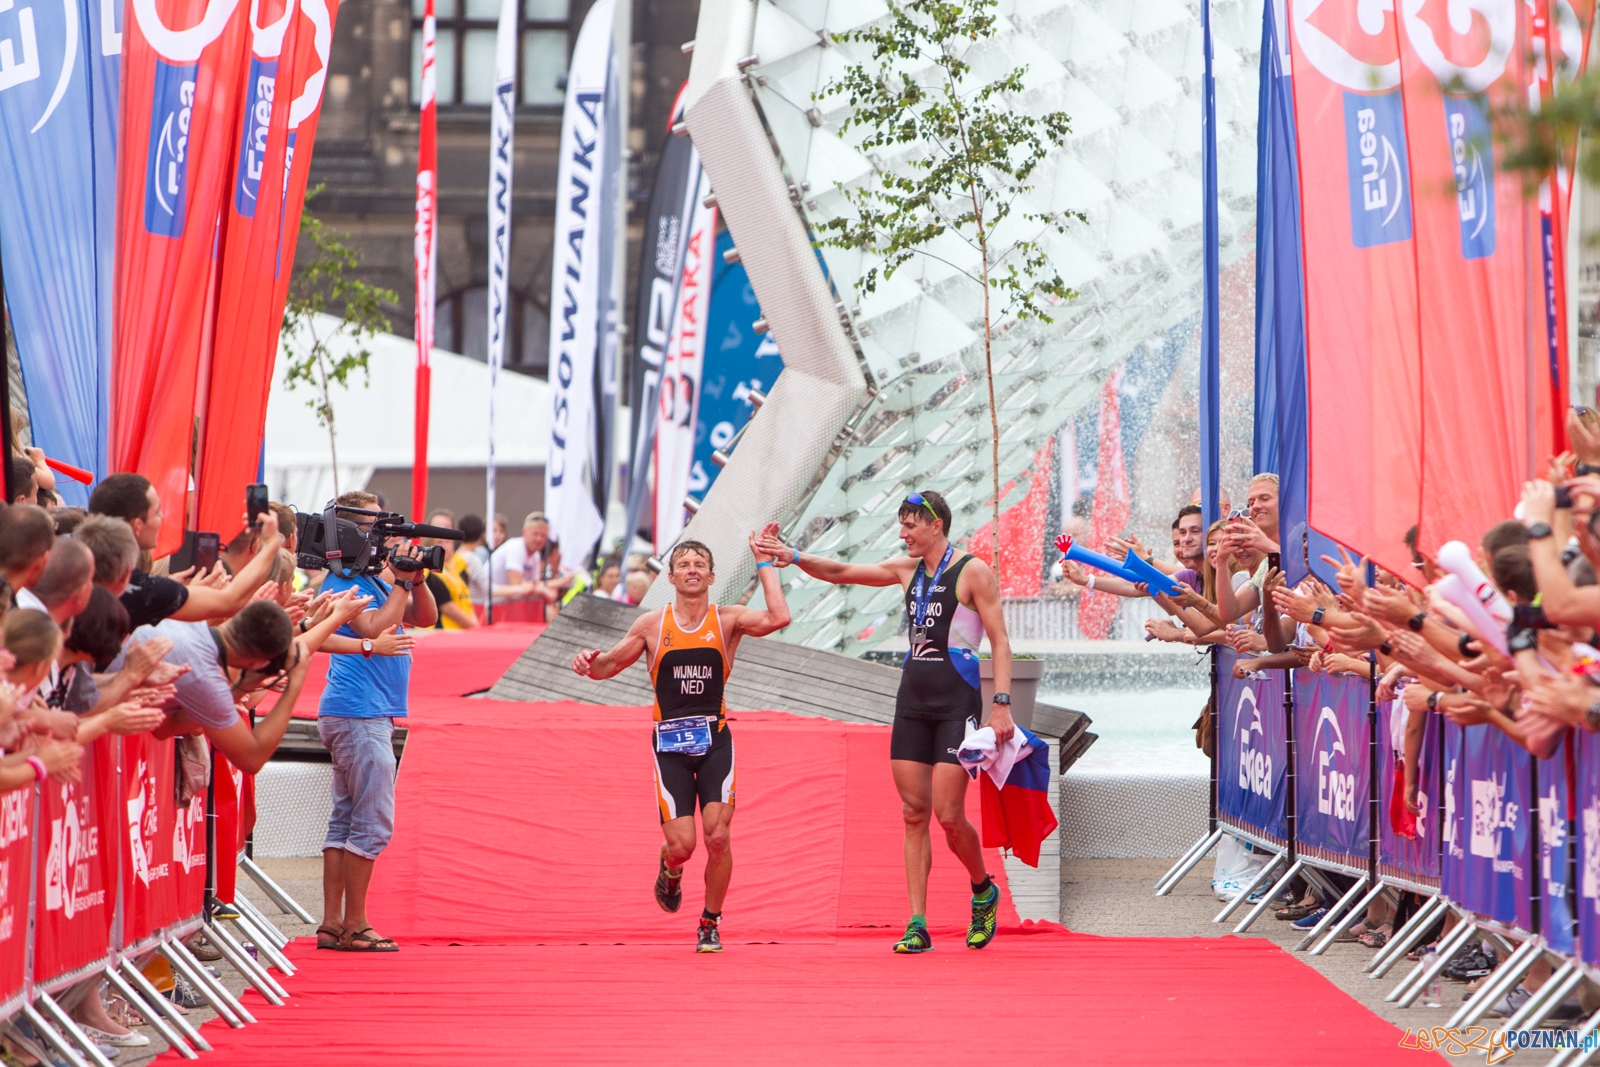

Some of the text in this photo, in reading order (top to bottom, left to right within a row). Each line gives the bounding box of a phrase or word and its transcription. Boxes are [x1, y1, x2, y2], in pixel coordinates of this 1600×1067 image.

[246, 75, 275, 181] Enea
[1356, 107, 1388, 211] Enea
[1449, 112, 1477, 222] Enea
[550, 91, 604, 487] CISOWIANKA
[909, 600, 943, 617] SAKO
[912, 617, 935, 628] SO
[673, 665, 712, 680] WIJNALDA
[680, 680, 705, 695] NED
[675, 731, 695, 742] 15
[1238, 729, 1272, 800] Enea
[1318, 750, 1355, 822] Enea
